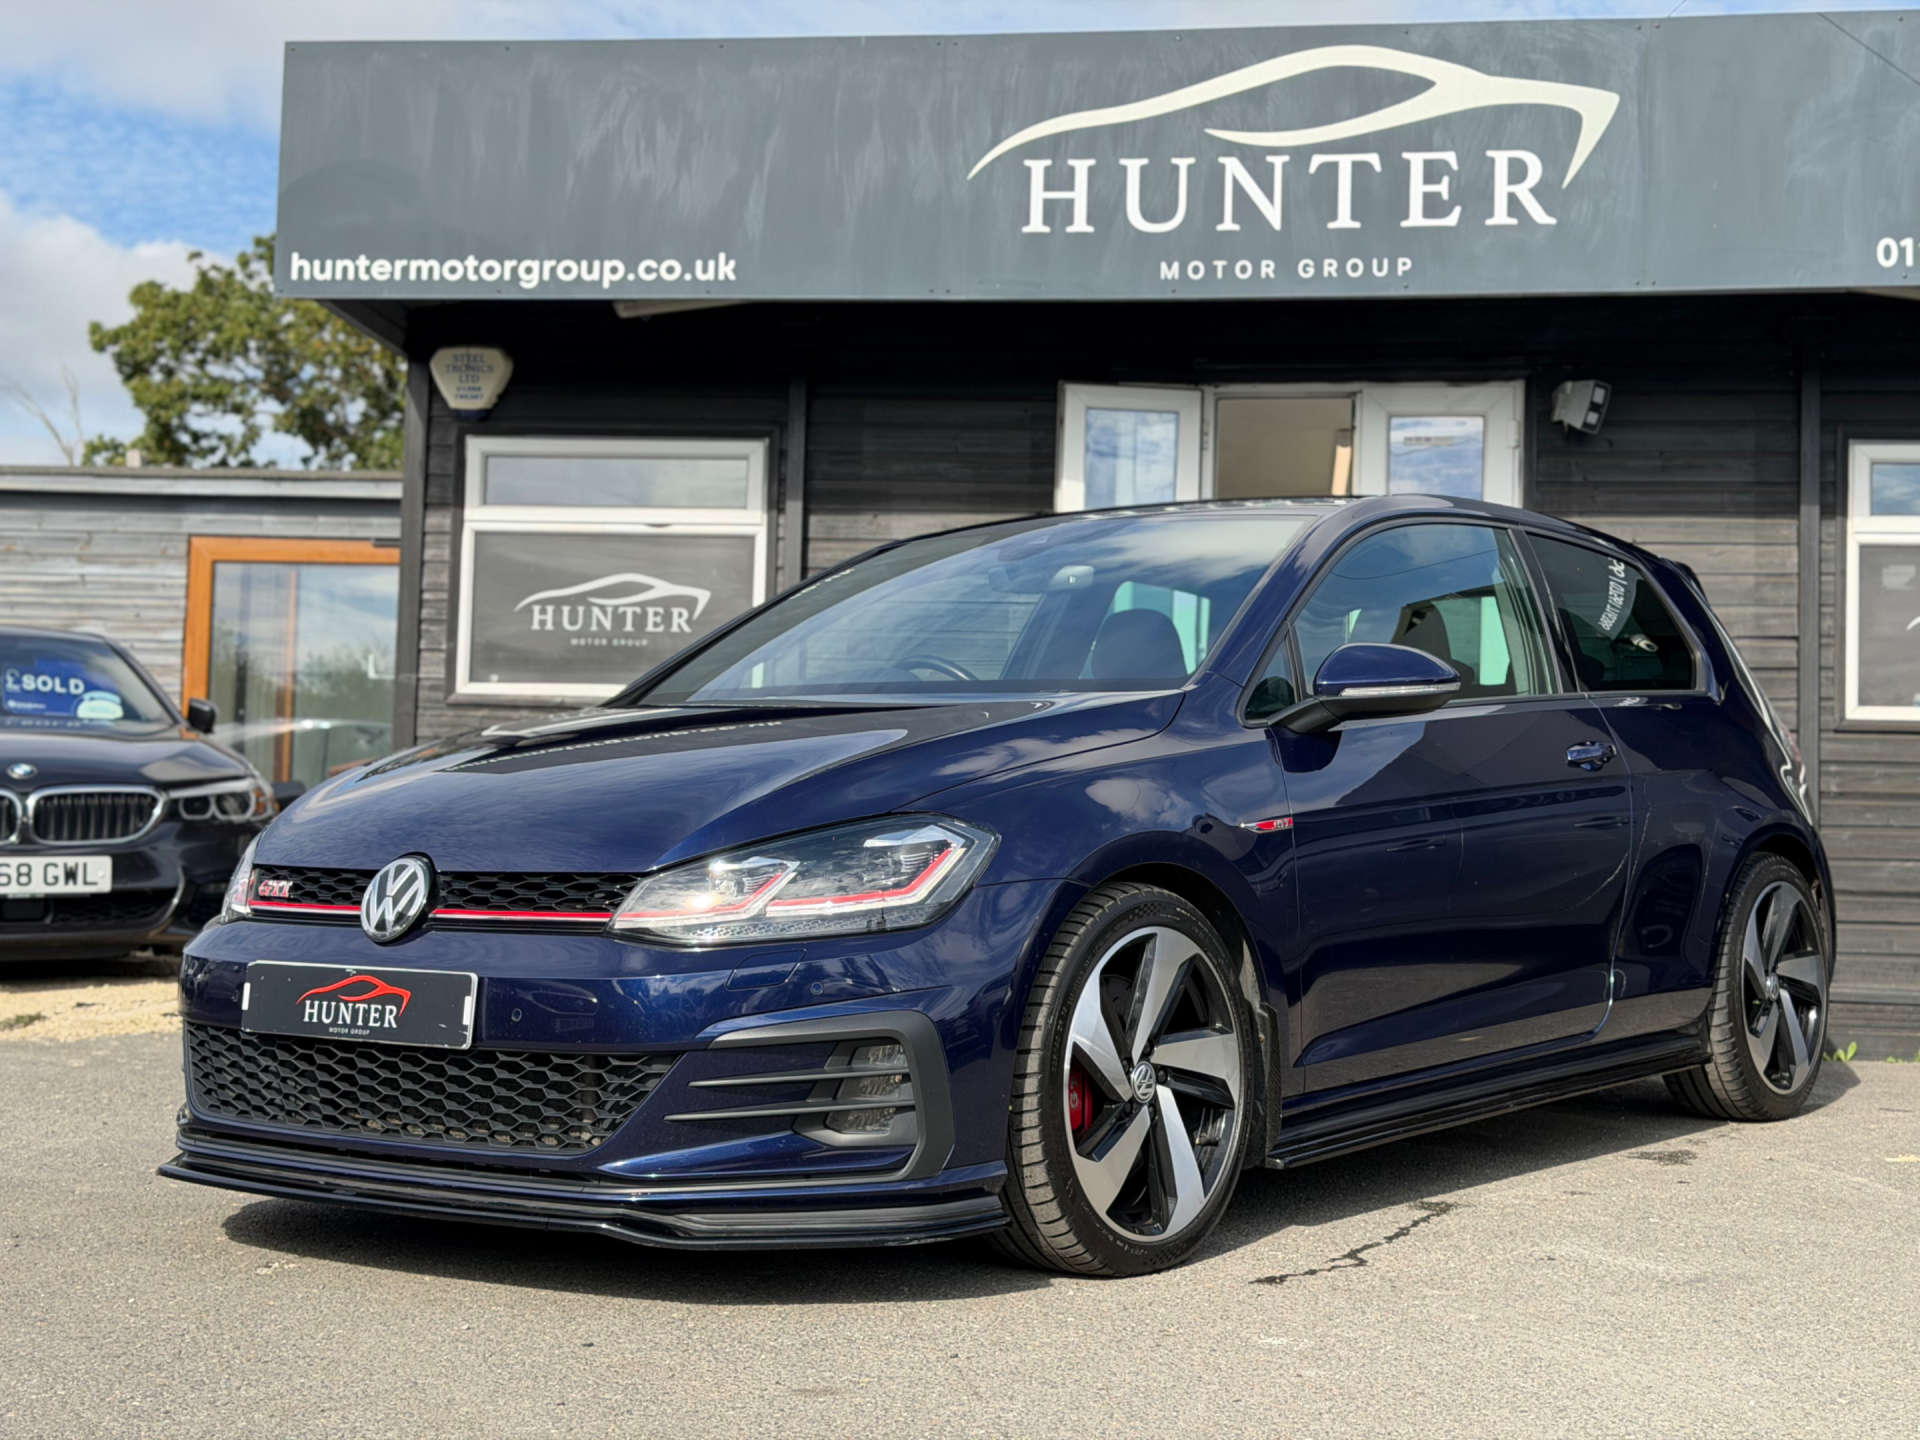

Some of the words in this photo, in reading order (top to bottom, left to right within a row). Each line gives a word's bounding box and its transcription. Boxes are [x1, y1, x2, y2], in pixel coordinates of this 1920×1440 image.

[1021, 149, 1557, 233] HUNTER
[1876, 236, 1920, 269] 01
[289, 252, 737, 289] huntermotorgroup.co.uk
[1159, 259, 1276, 281] MOTOR
[1297, 257, 1413, 280] GROUP
[529, 604, 692, 633] HUNTER
[570, 636, 608, 647] MOTOR
[611, 636, 649, 648] GROUP
[43, 861, 99, 887] GWL
[258, 879, 293, 897] GTI
[303, 999, 398, 1029] HUNTER
[328, 1026, 349, 1034] MOTOR
[350, 1028, 370, 1036] GROUP
